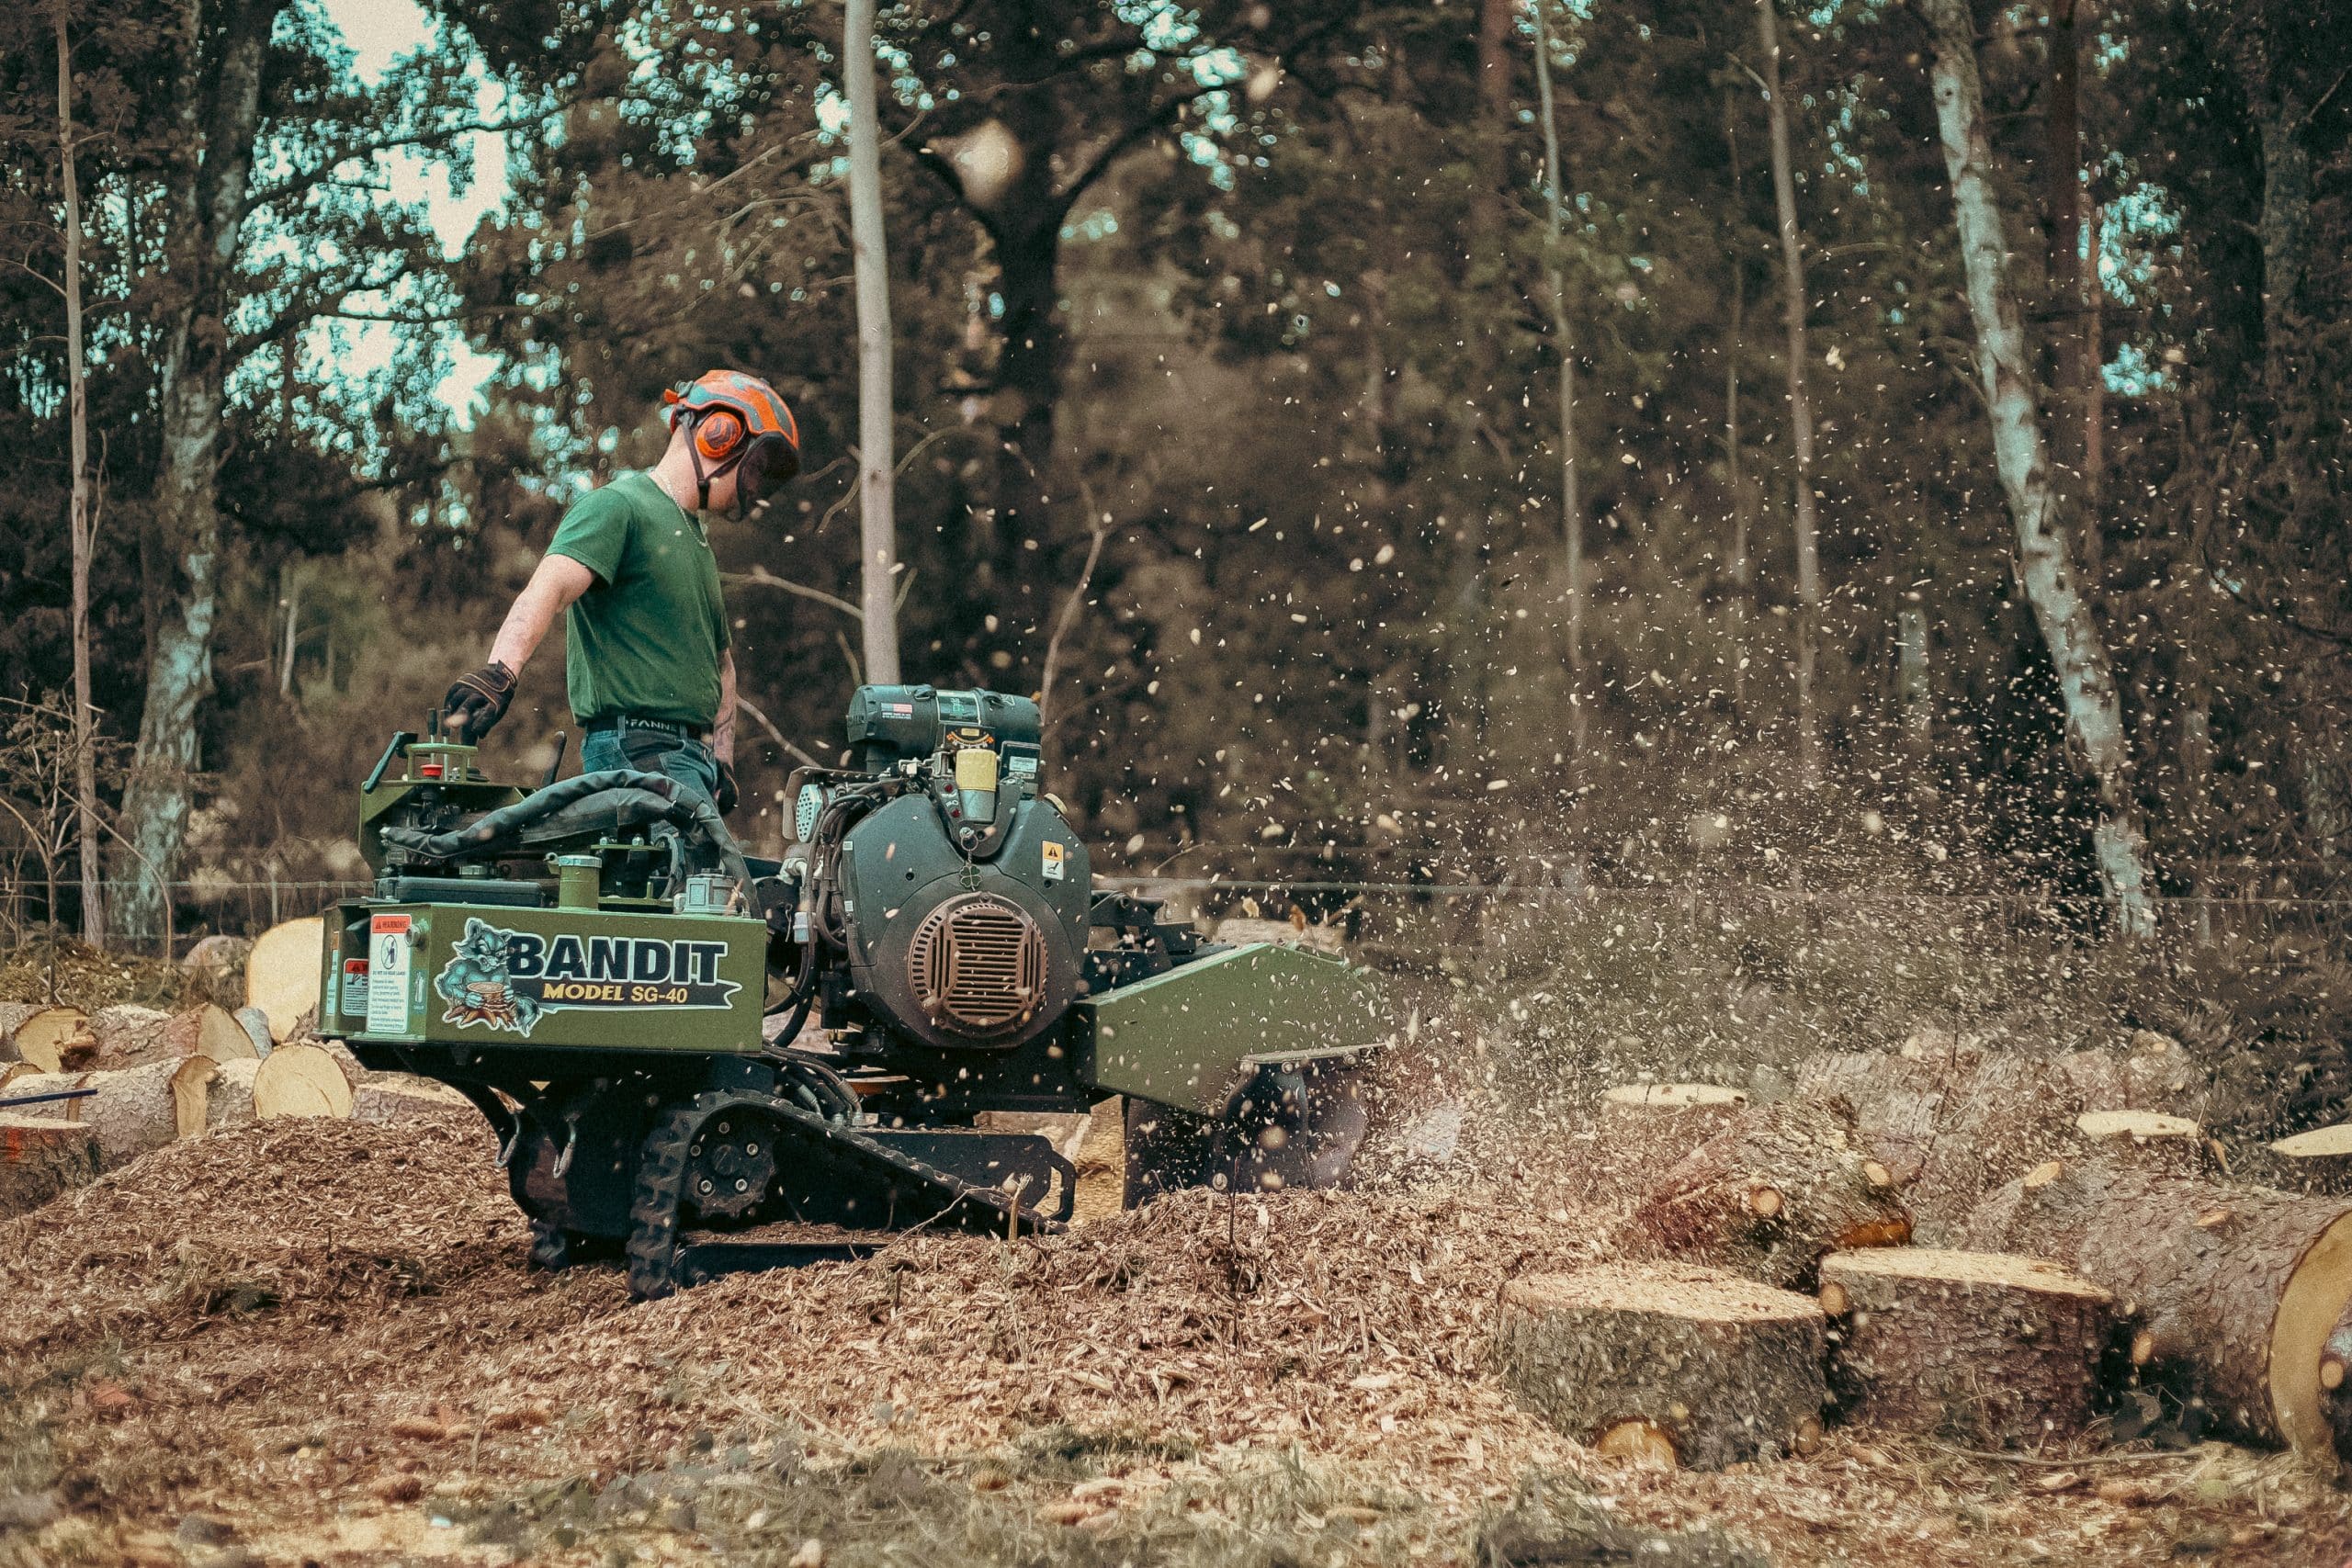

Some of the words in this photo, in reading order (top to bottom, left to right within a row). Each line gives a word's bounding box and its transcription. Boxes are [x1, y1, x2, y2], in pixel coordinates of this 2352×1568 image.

[506, 934, 726, 985] BANDIT
[542, 983, 625, 1002] MODEL
[630, 986, 688, 1004] SG-40
